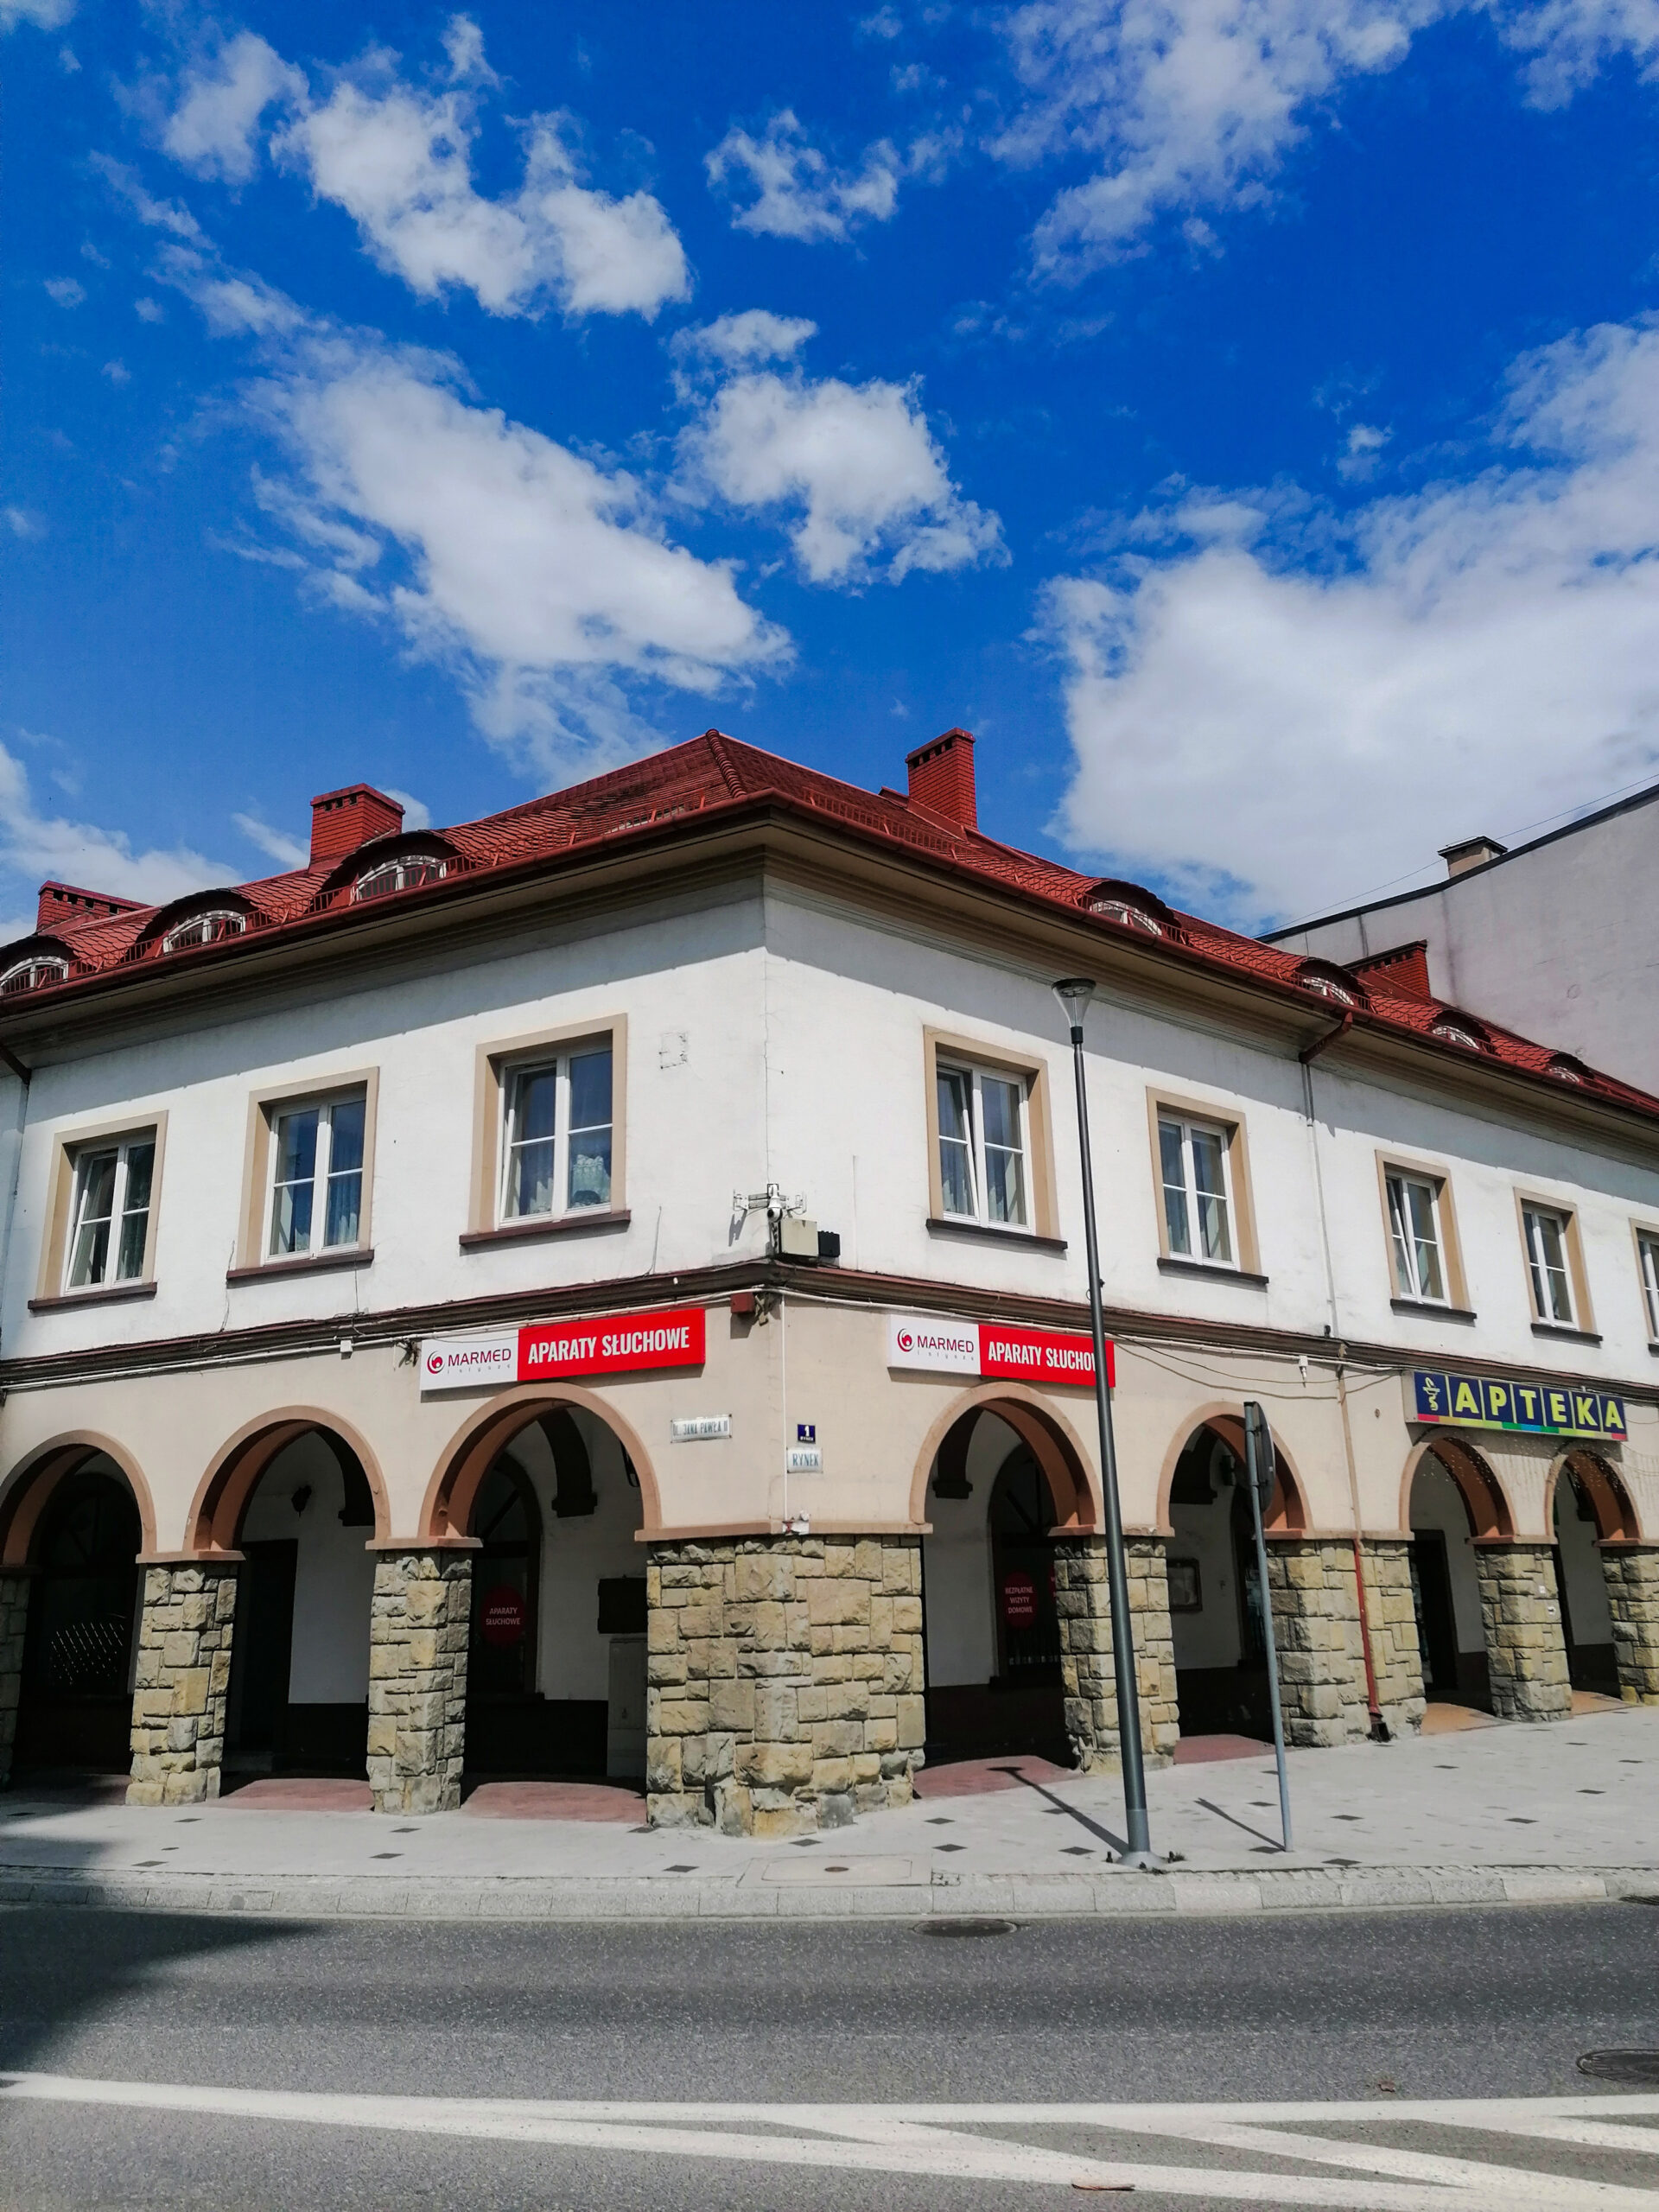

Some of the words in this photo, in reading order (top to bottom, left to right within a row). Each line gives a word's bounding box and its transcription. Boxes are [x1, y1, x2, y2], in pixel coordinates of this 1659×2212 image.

[527, 1336, 597, 1365] APARATY
[601, 1326, 690, 1357] SŁUCHOWE
[917, 1335, 974, 1353] MARMED
[448, 1348, 512, 1367] MARMED
[988, 1341, 1042, 1367] APARATY
[1046, 1347, 1096, 1372] SŁUCHO
[1455, 1382, 1624, 1430] APTEKA
[683, 1423, 697, 1435] JANA
[700, 1421, 721, 1434] PAWŁA
[804, 1425, 810, 1436] 1
[792, 1453, 819, 1466] RYNEK
[1007, 1605, 1033, 1614] DOMOWE
